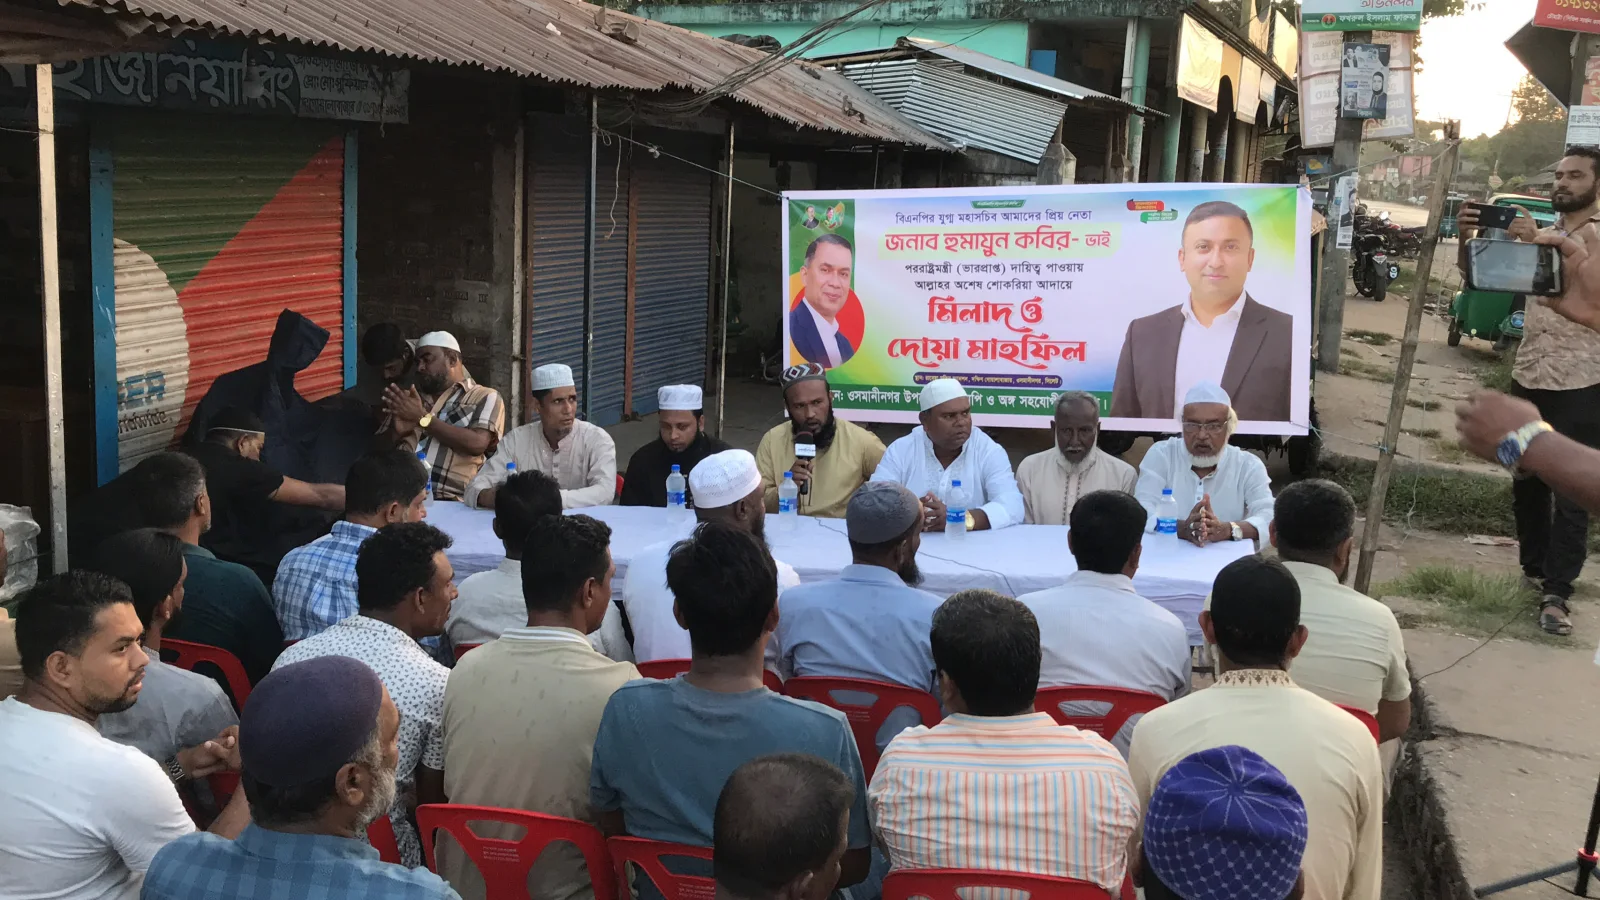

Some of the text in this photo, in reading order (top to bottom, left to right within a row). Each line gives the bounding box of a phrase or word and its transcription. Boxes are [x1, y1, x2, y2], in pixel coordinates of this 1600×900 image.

[896, 209, 1092, 225] বিএনপির যুগ্ম মহাসচিব আমাদের প্রিয় নেতা
[885, 233, 939, 251] জনাব
[943, 232, 1010, 257] হুমায়ুন
[1085, 231, 1112, 248] ভাই
[905, 261, 1085, 276] পররাষ্ট্রমন্ত্রী (ভারপ্রাপ্ত) দায়িত্ব পাওয়ায়
[954, 280, 983, 290] অশেষ
[986, 278, 1033, 291] শোকরিয়া
[1036, 279, 1074, 290] আদায়ে
[928, 296, 1034, 333] মিলাদ
[887, 333, 1088, 370] দোয়া মাহফিল
[847, 387, 900, 404] ওসমানীনগর
[998, 395, 1016, 408] অঙ্গ
